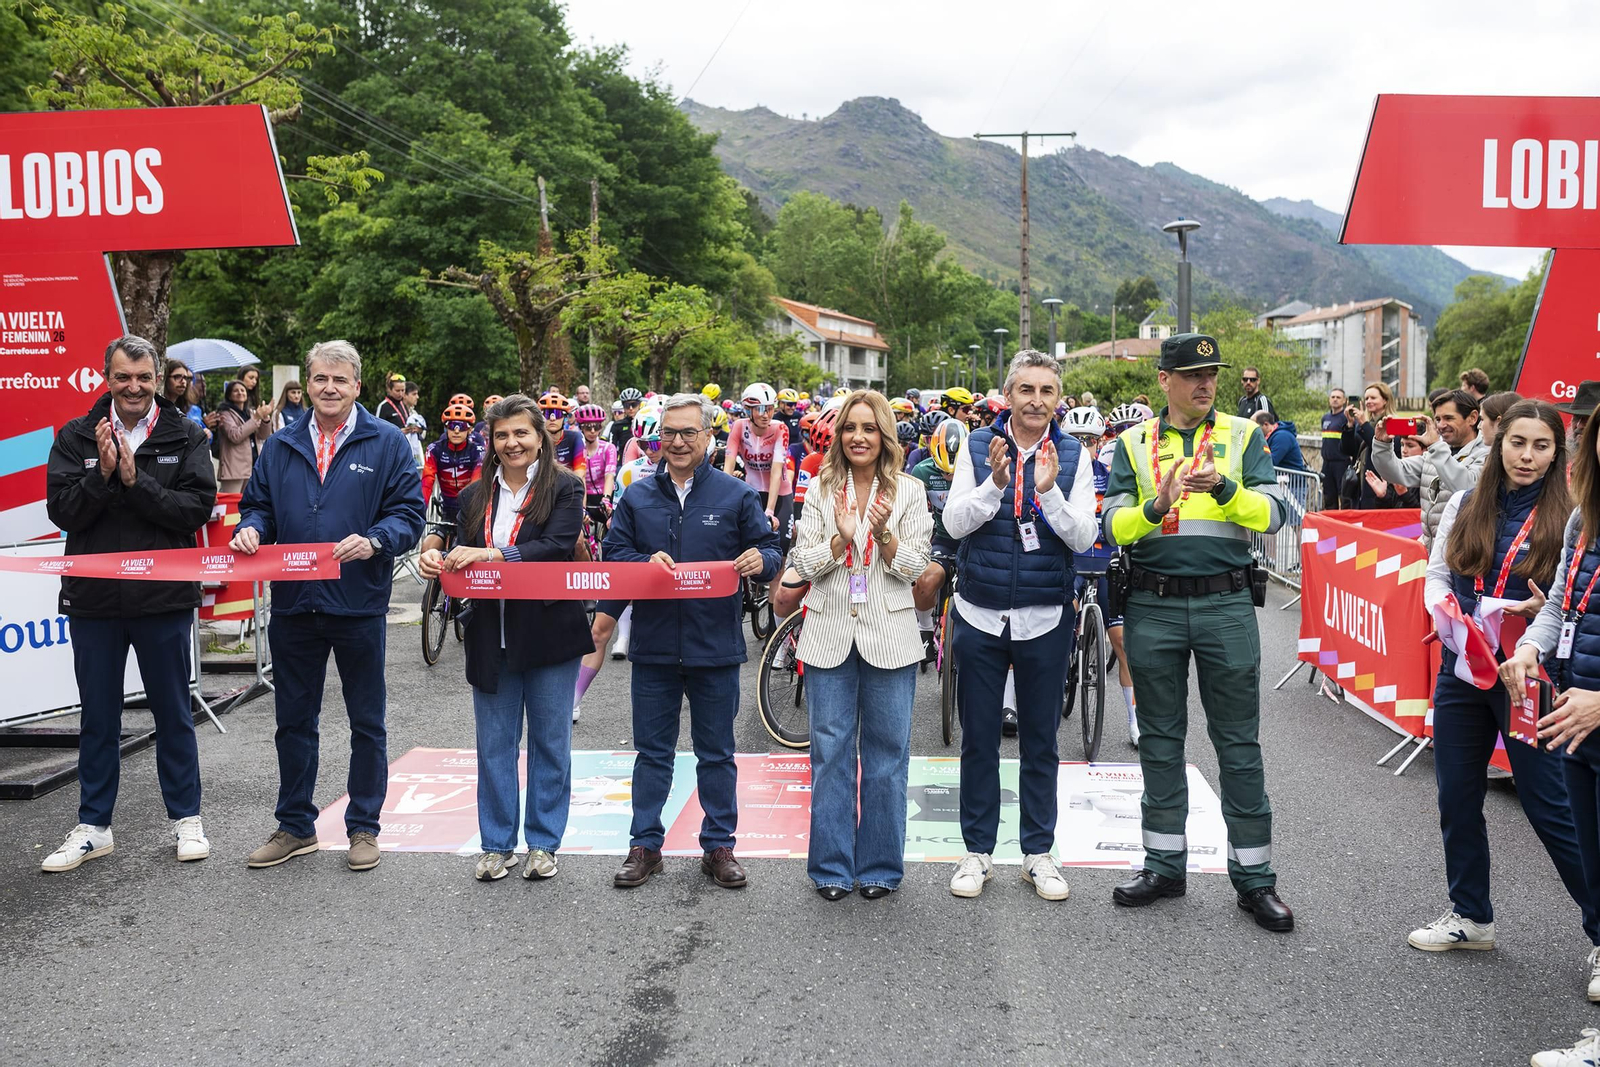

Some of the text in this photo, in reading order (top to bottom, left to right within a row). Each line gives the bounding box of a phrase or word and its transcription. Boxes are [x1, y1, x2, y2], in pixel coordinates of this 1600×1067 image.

[1482, 138, 1599, 209] LOBI
[0, 147, 164, 219] LOBIOS
[8, 311, 65, 330] VUELTA
[2, 331, 65, 343] FEMENINA 26
[0, 372, 61, 389] rrefour
[130, 558, 154, 567] VUELTA
[210, 555, 235, 564] VUELTA
[292, 552, 317, 561] VUELTA
[465, 570, 501, 579] LA VUELTA
[566, 572, 610, 590] LOBIOS
[674, 571, 711, 580] LA VUELTA
[1323, 582, 1387, 656] LA VUELTA
